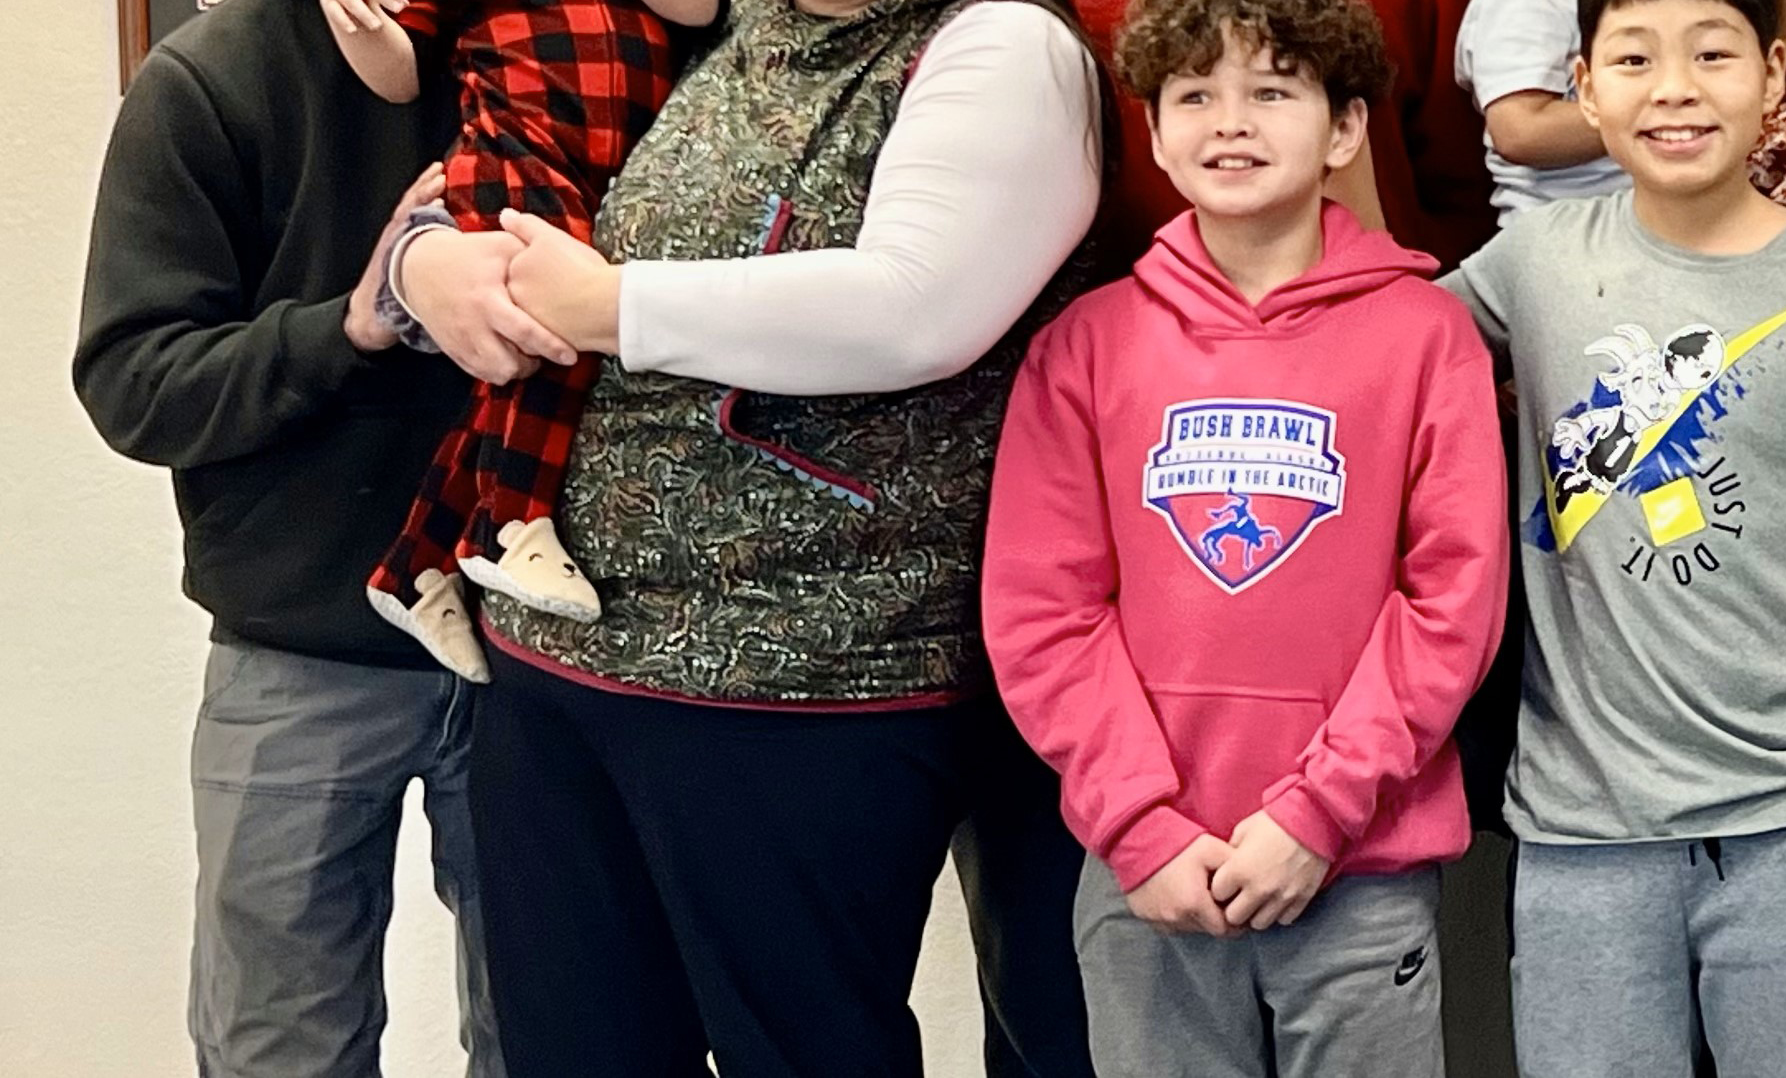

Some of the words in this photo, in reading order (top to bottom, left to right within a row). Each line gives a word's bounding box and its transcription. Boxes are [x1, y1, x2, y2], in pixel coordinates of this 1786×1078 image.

[1179, 414, 1233, 441] BUSH
[1241, 415, 1316, 446] BRAWL
[1222, 469, 1237, 484] IN
[1245, 469, 1270, 485] THE
[1277, 471, 1329, 497] ARCTIC
[1697, 456, 1746, 539] JUST
[1672, 542, 1720, 586] DO
